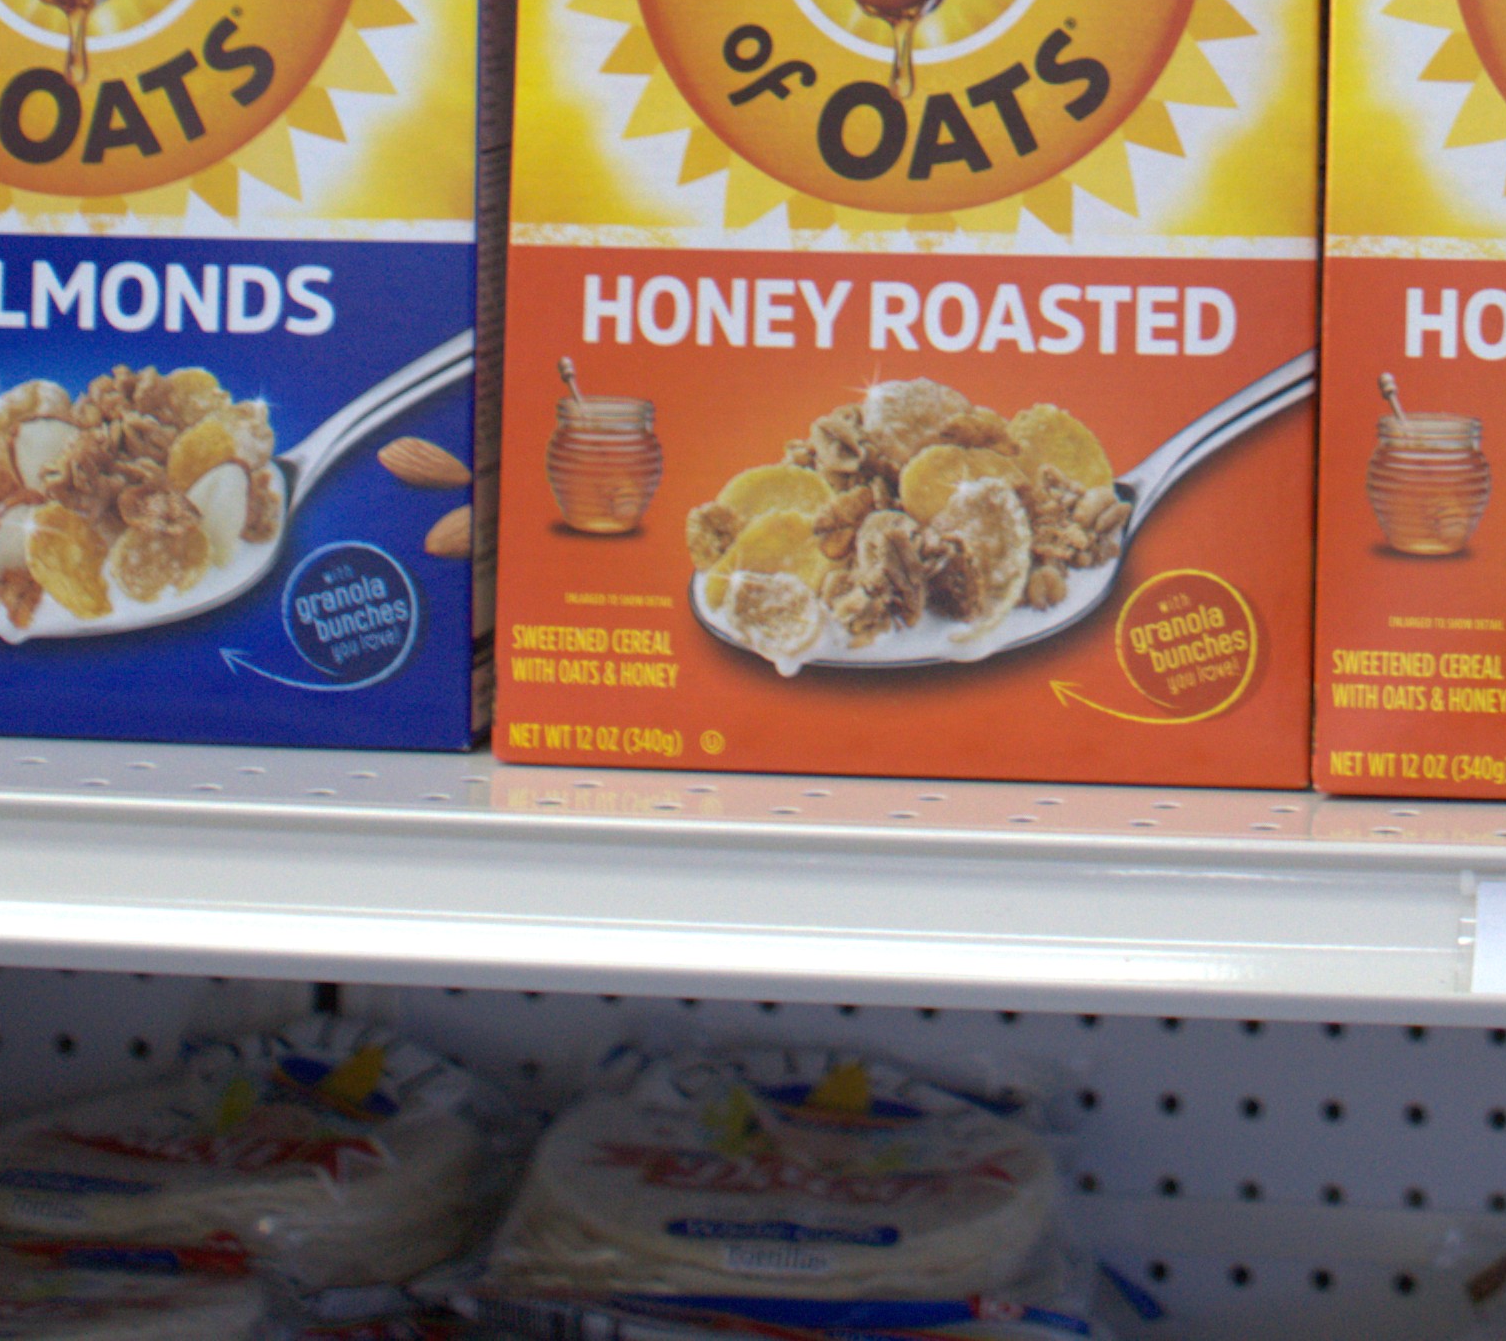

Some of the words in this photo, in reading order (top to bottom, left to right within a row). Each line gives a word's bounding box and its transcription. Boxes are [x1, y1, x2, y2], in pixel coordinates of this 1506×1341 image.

[817, 25, 1111, 183] OATS
[582, 274, 853, 350] HONEY
[869, 282, 1238, 357] ROASTED
[1332, 649, 1435, 678] SWEETENED
[1439, 653, 1504, 680] CEREAL
[1332, 683, 1380, 710] WITH
[1383, 685, 1428, 711] OATS
[1430, 687, 1445, 711] &
